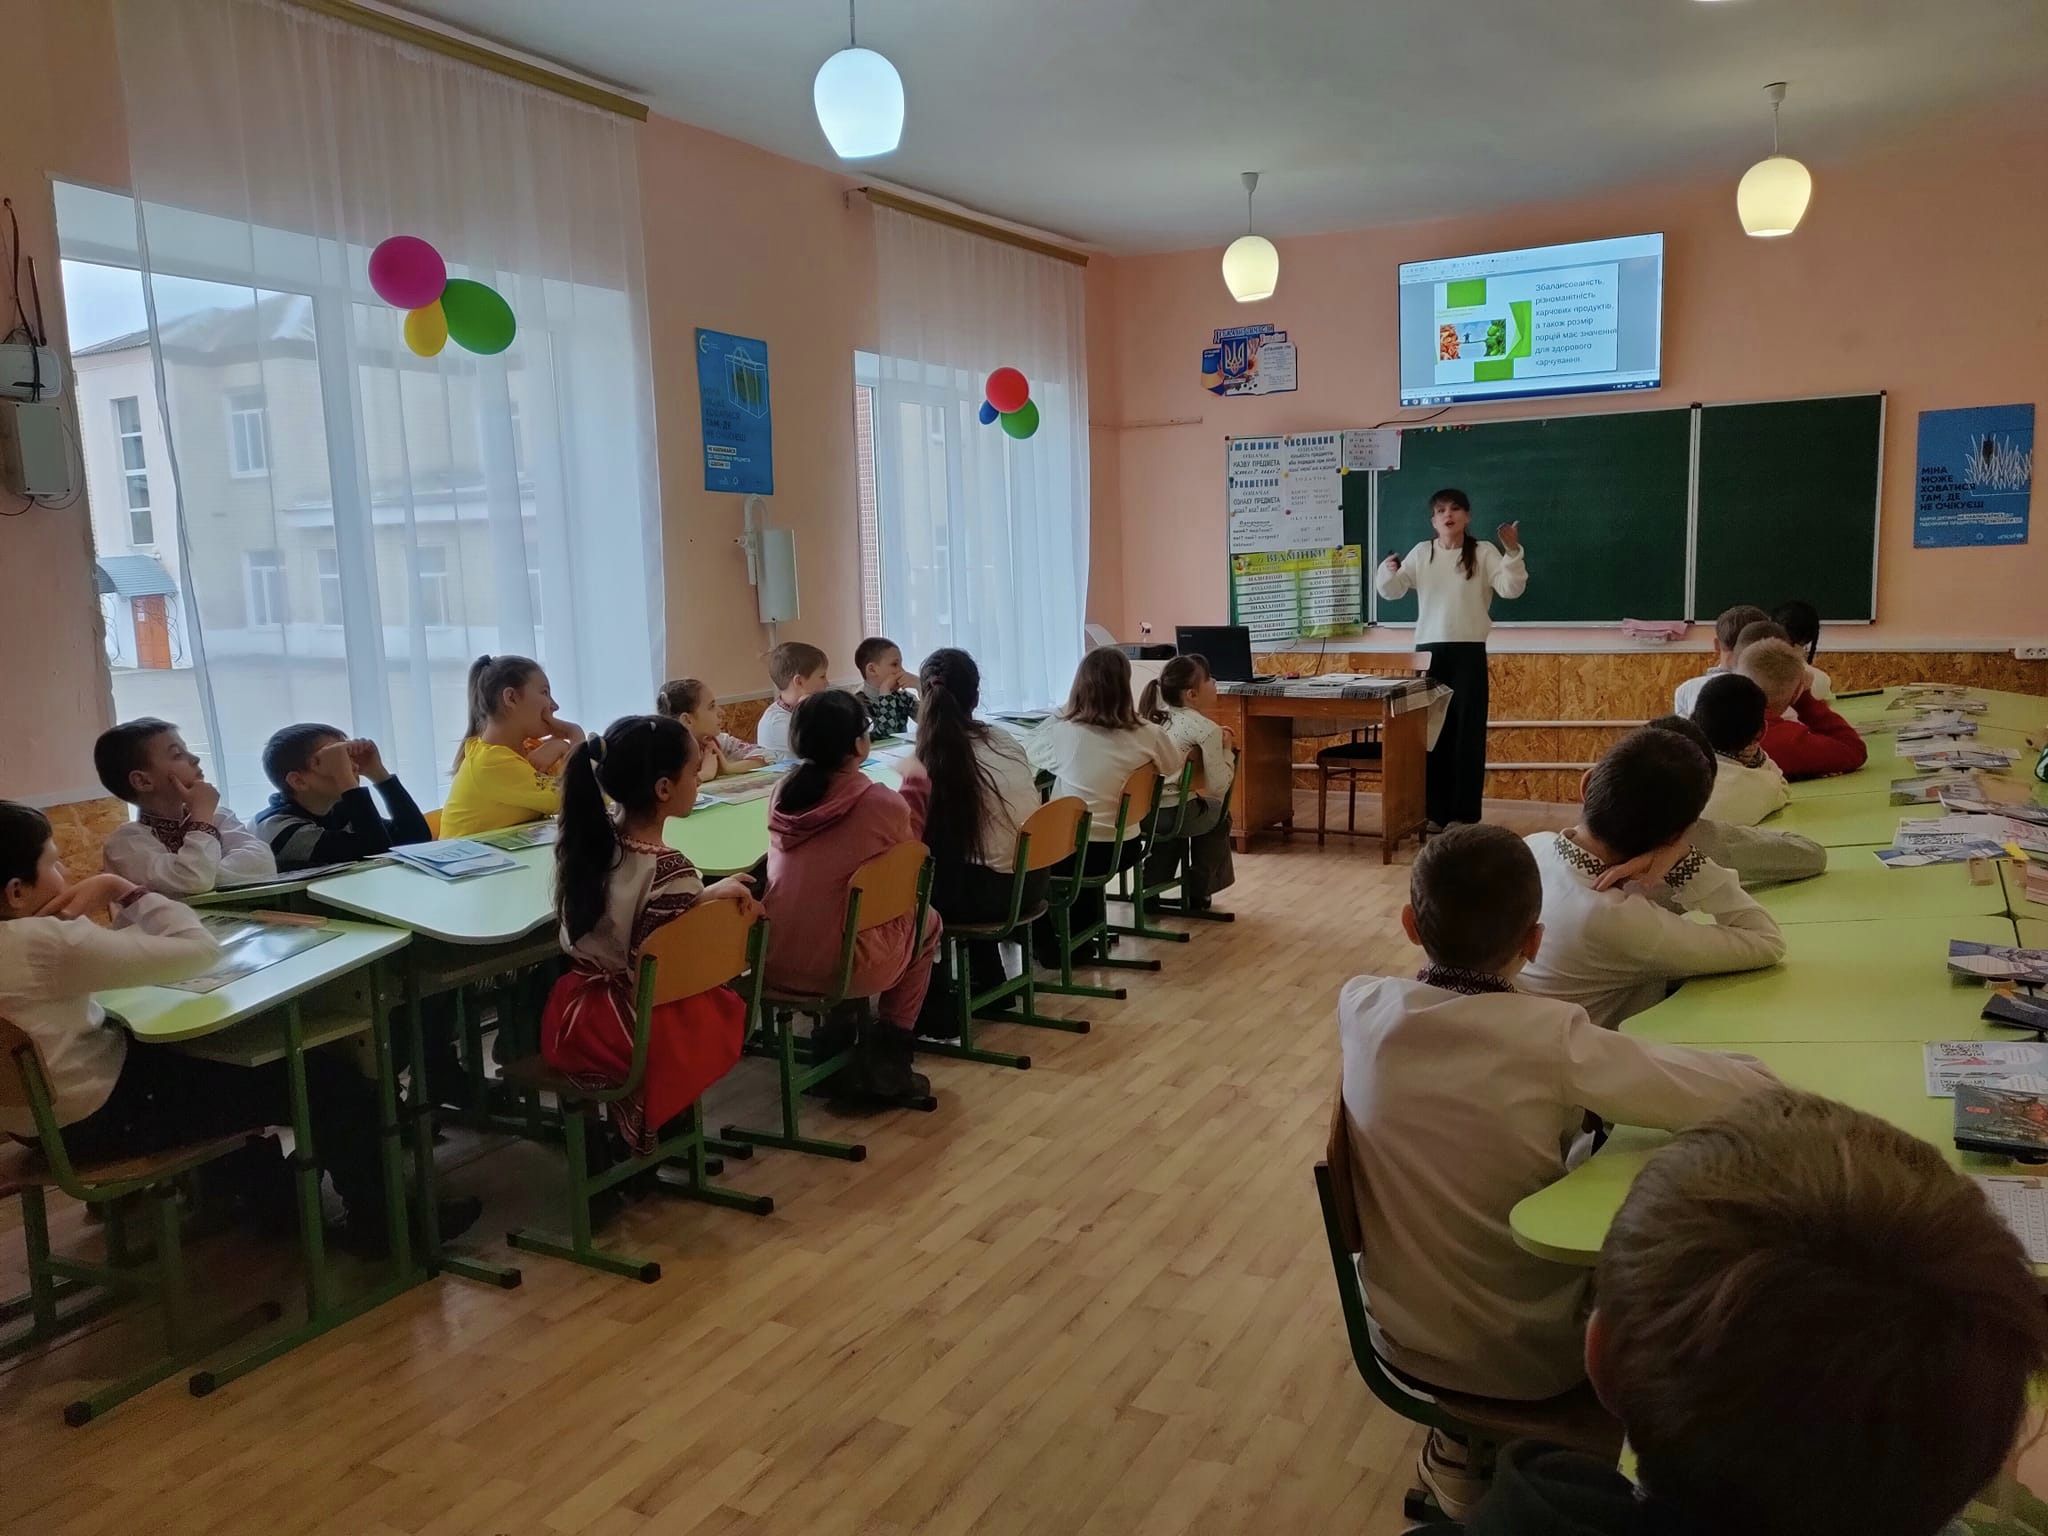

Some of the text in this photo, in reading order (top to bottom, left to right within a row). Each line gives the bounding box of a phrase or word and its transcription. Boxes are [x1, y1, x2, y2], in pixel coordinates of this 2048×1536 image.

[1543, 320, 1565, 328] також
[1567, 316, 1594, 327] розмір
[1535, 342, 1592, 355] для здорового
[1284, 436, 1335, 448] ЧИСЛІВНИК
[1921, 466, 1948, 475] МІНА
[1921, 475, 1953, 484] МОЖЕ
[1920, 482, 1976, 493] ХОВАТИСЯ
[1920, 492, 1961, 502] ТАМ, ДЕ
[1920, 500, 1984, 511] НЕ ОЧІКУЄШ
